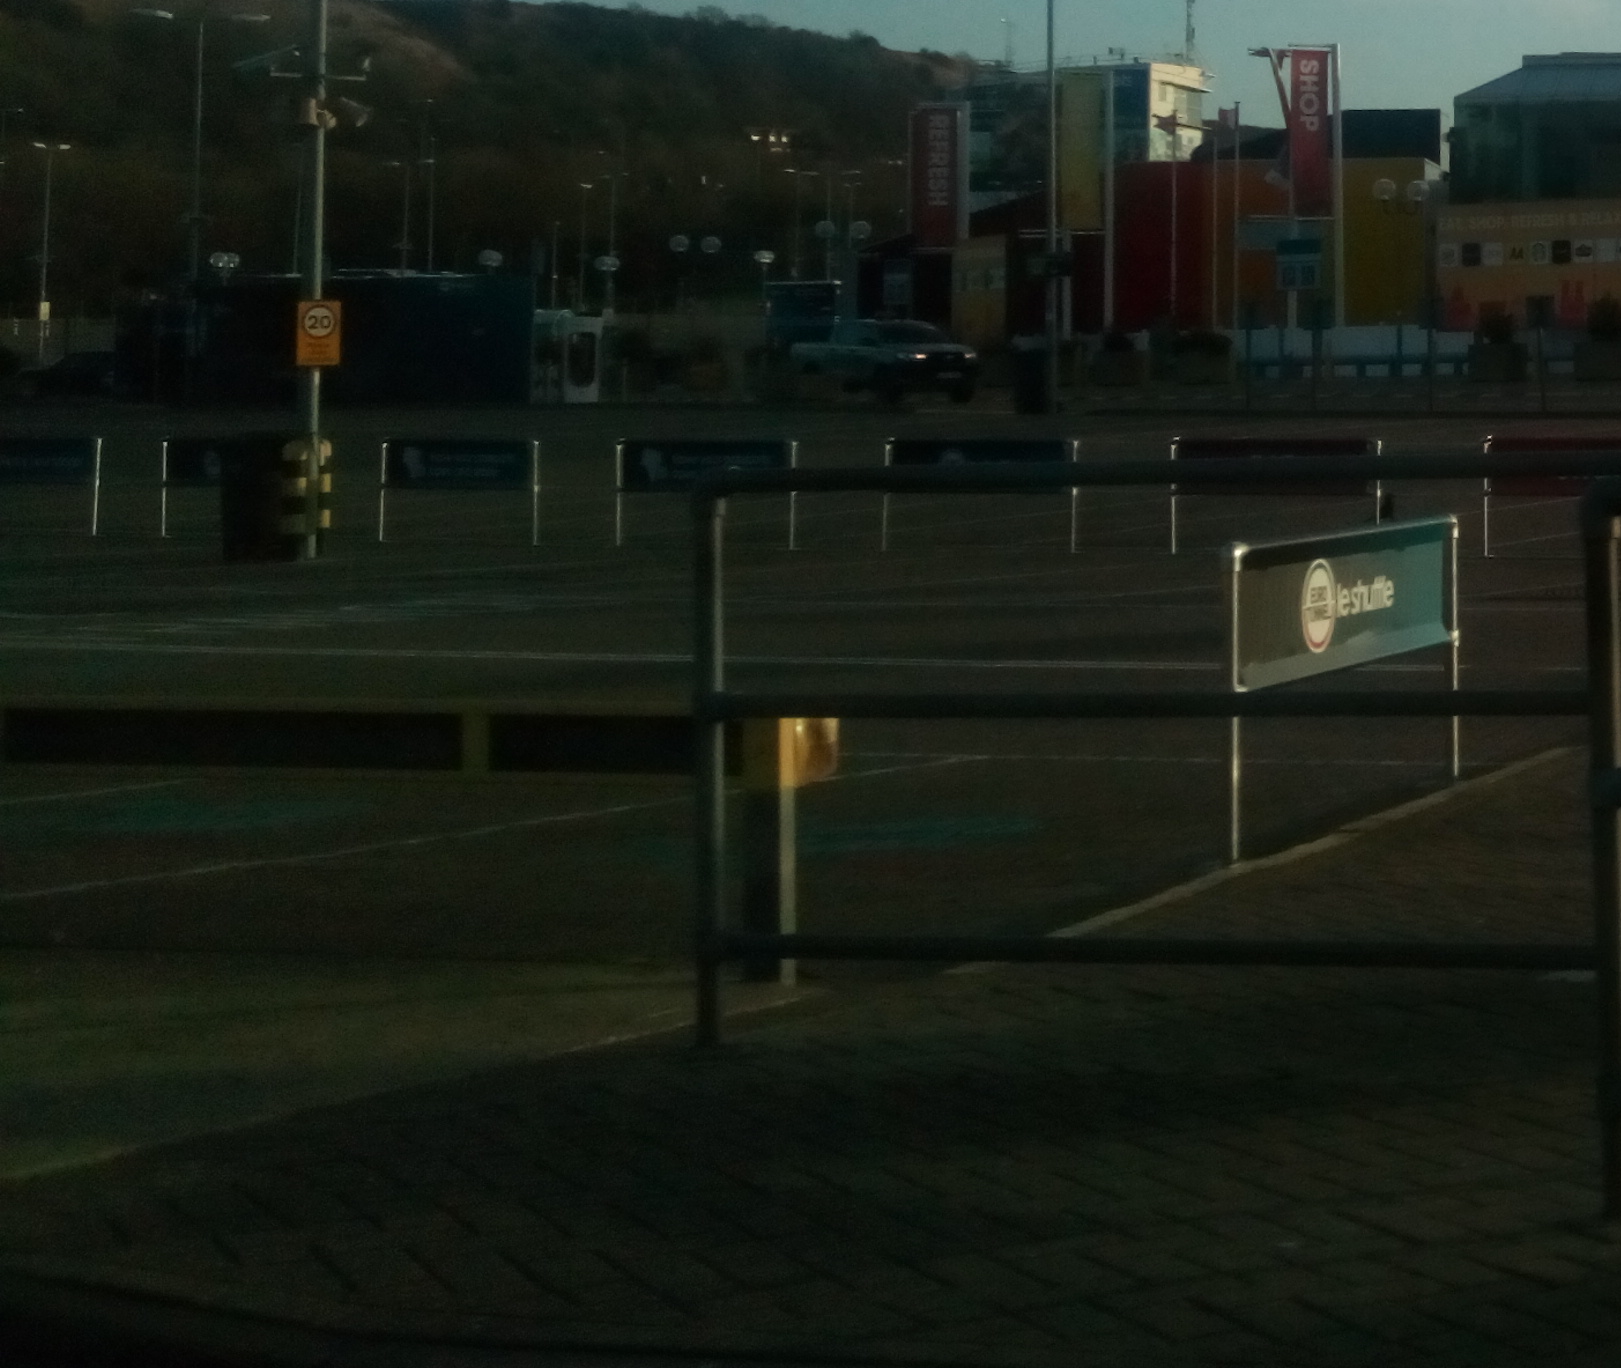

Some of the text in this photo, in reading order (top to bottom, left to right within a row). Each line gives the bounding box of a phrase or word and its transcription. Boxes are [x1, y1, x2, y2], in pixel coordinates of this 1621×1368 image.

[1300, 59, 1319, 132] SHOP
[928, 114, 950, 206] REFRESH
[307, 315, 332, 330] 20
[1336, 575, 1395, 619] le shuttle
